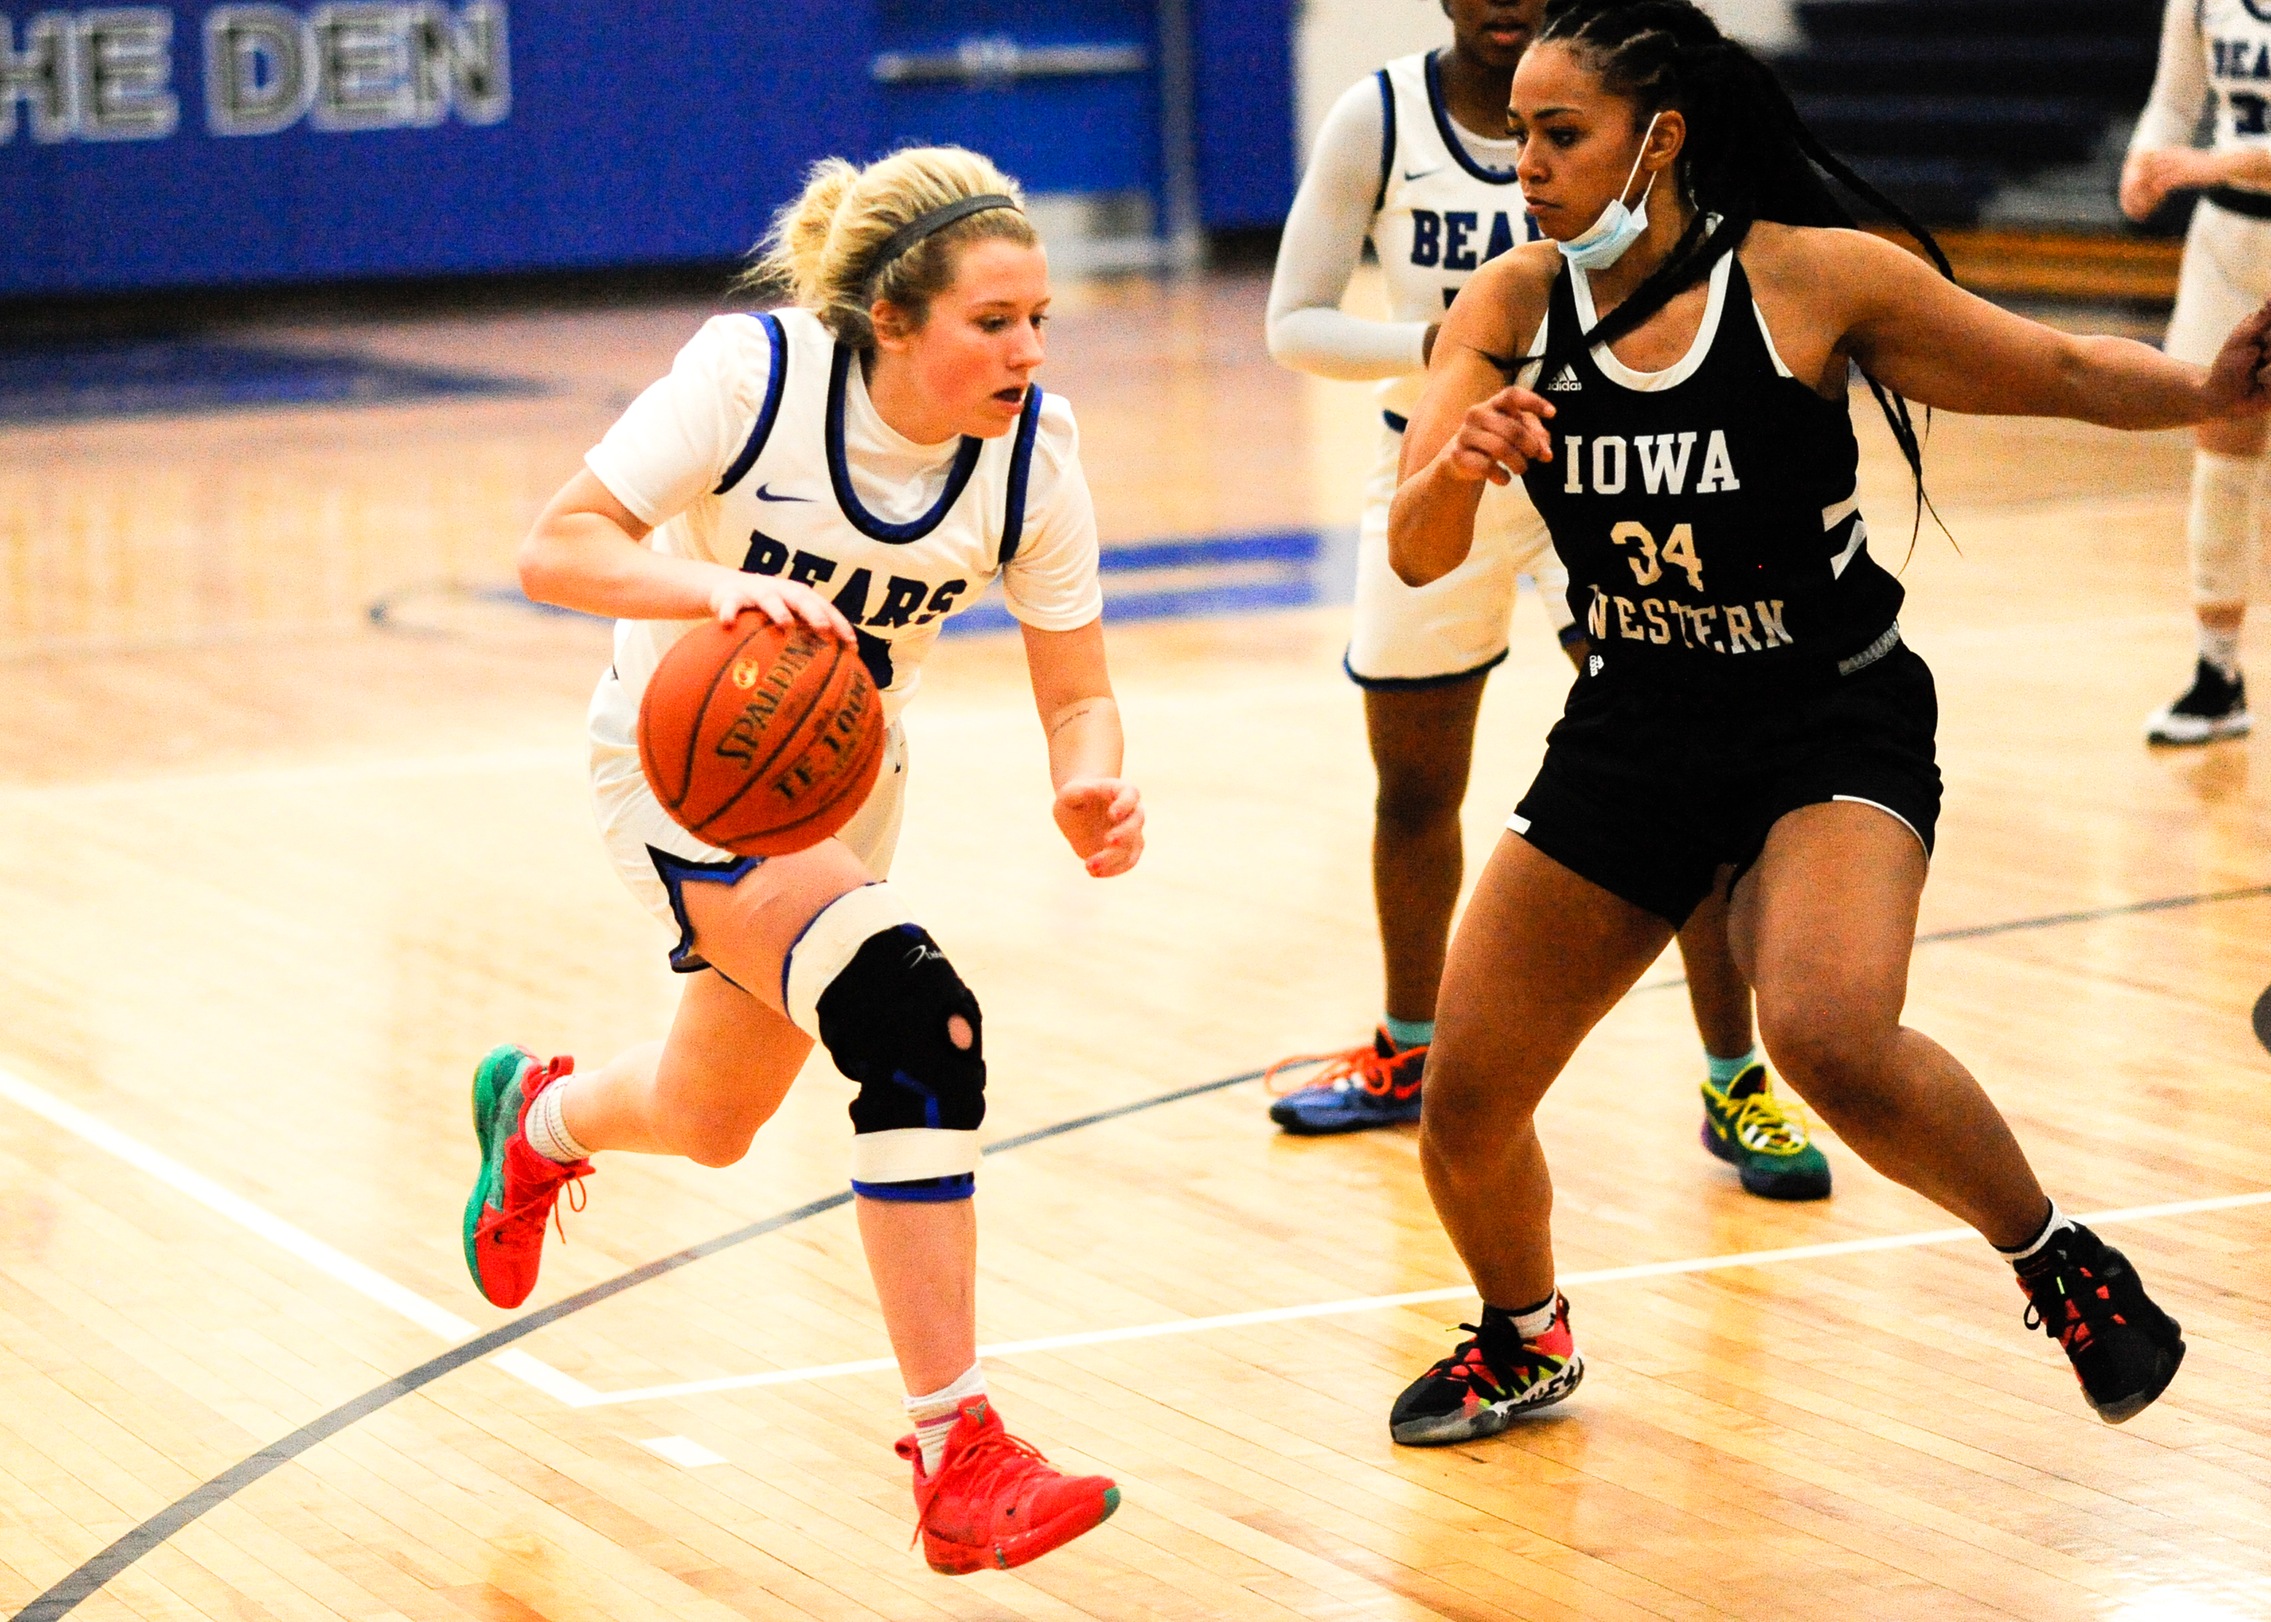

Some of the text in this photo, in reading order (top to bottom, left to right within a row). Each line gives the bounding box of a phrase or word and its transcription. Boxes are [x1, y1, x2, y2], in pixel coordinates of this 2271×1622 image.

[205, 0, 512, 136] DEN
[1564, 429, 1740, 494] IOWA
[739, 529, 967, 628] BEARS
[1610, 521, 1704, 592] 34
[715, 622, 828, 770] SPALDIN
